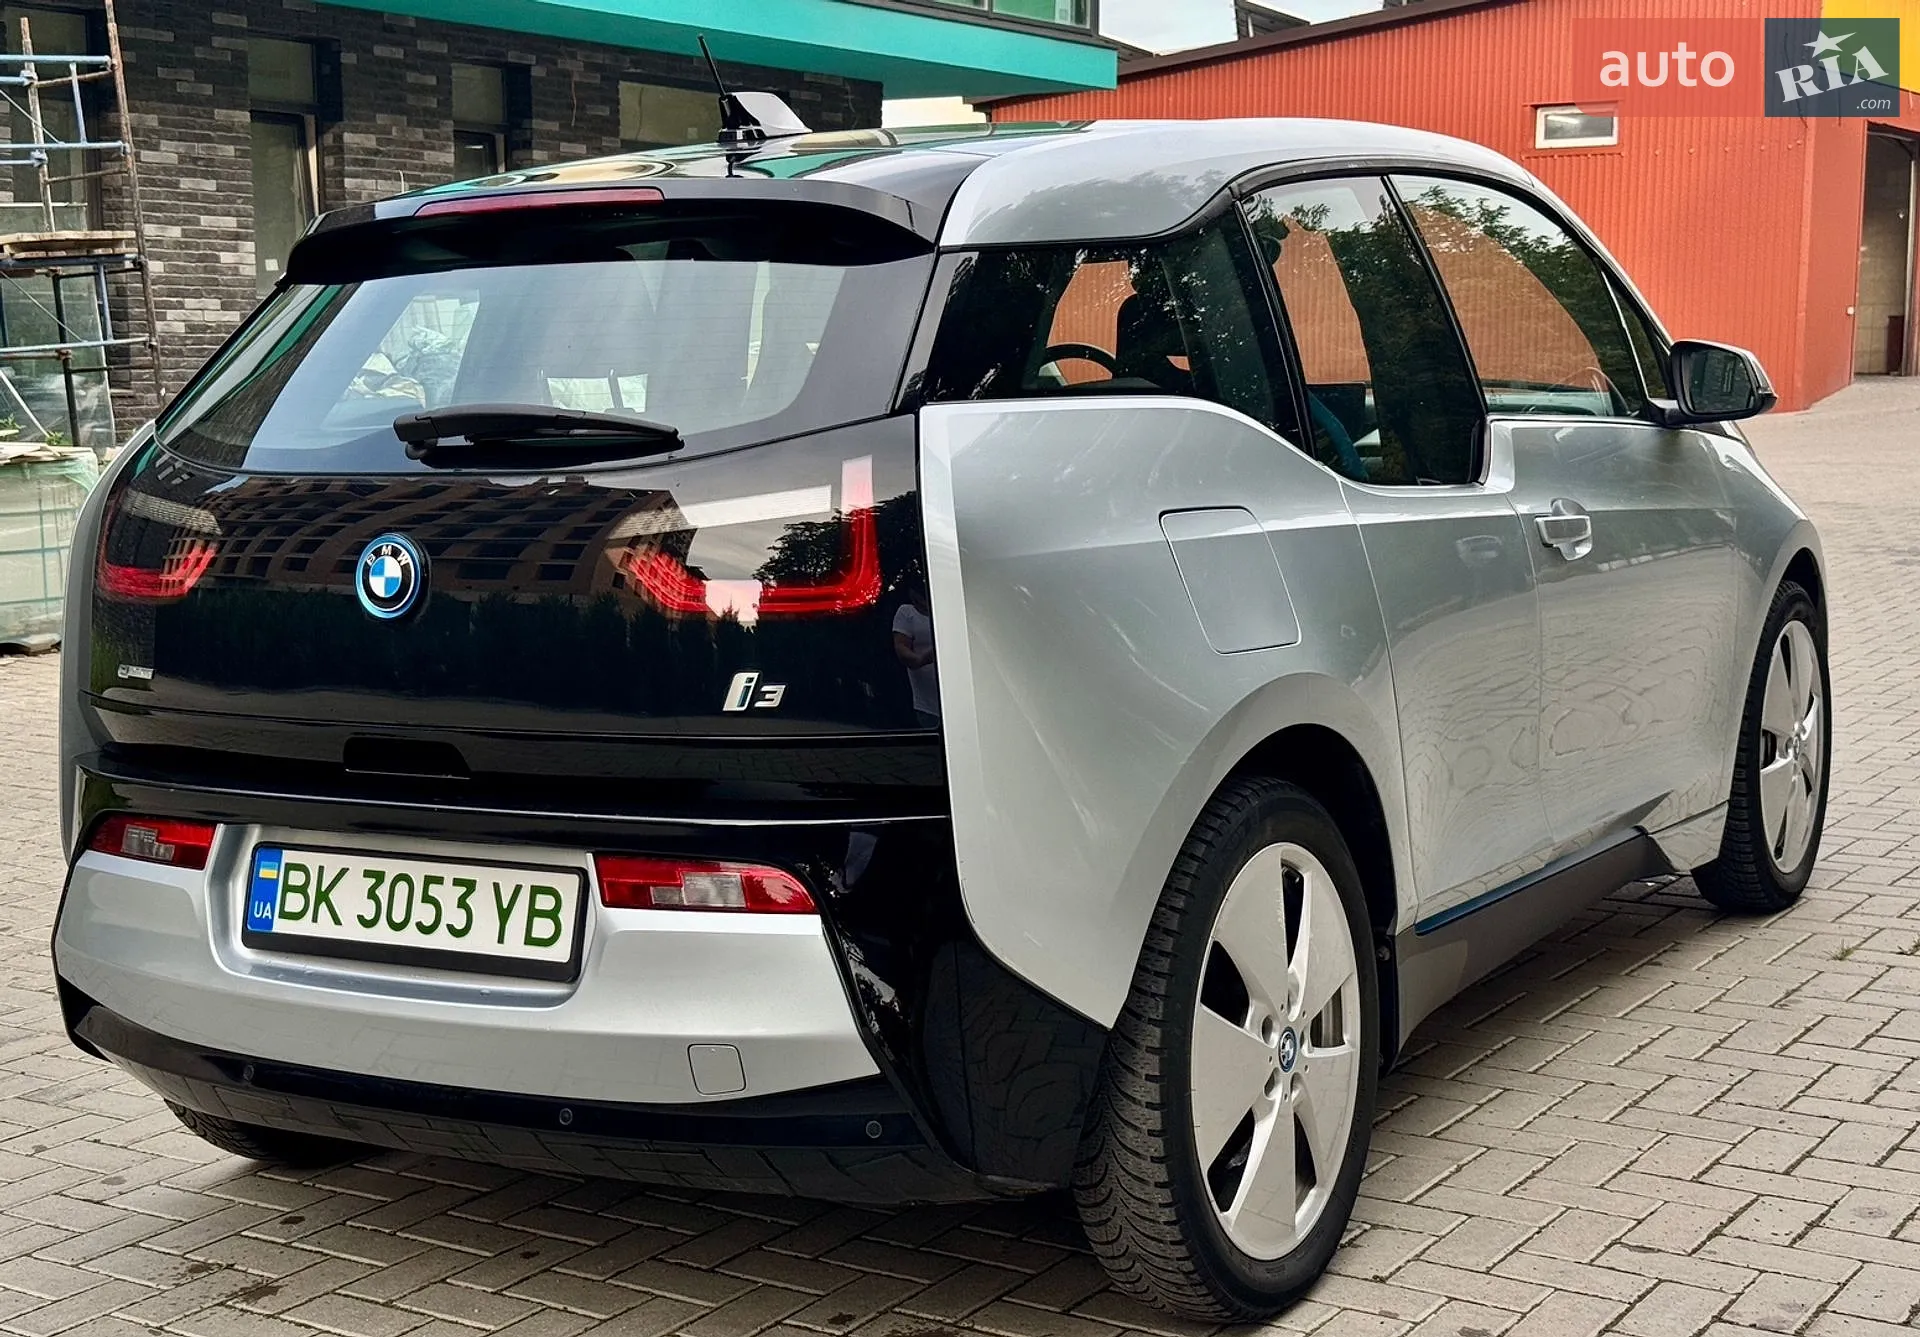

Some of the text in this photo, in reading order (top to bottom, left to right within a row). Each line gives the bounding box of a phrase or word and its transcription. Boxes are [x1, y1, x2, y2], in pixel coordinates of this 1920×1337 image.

[366, 544, 411, 567] BMW
[722, 672, 786, 711] i3
[253, 901, 273, 921] UA
[277, 862, 563, 948] BK 3053 YB
